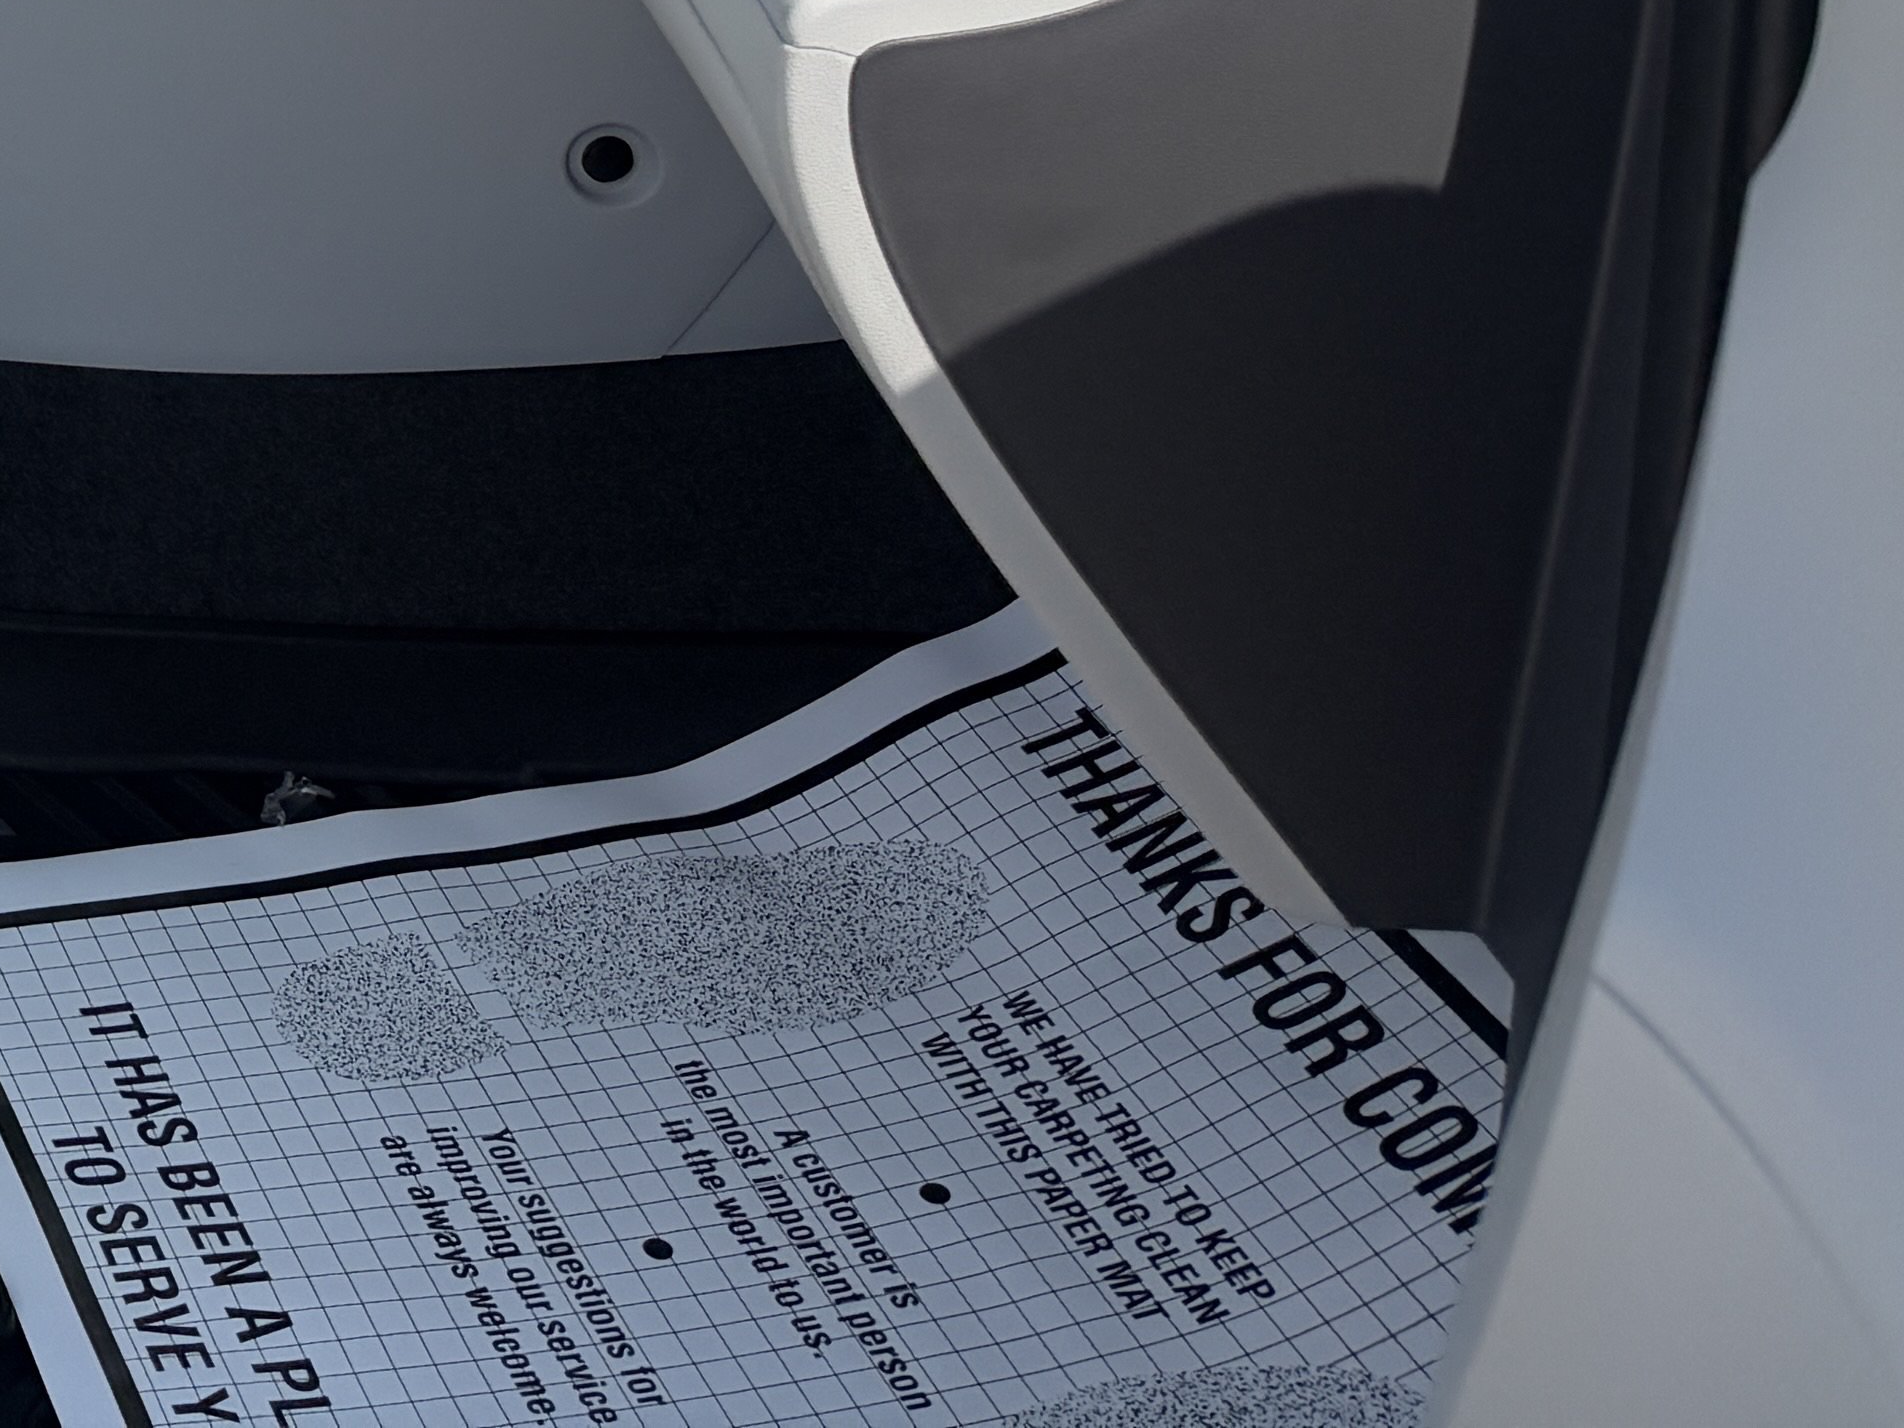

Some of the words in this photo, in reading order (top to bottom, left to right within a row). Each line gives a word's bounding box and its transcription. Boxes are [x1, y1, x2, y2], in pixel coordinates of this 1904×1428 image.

[79, 1002, 148, 1039] IT
[1020, 707, 1265, 944] THANKS
[1216, 932, 1386, 1078] FOR
[1343, 1067, 1498, 1245] COM
[52, 1125, 127, 1186] TO
[105, 1055, 198, 1147] HAS
[921, 1032, 992, 1100] WITH
[976, 1100, 1043, 1163] THIS
[1025, 1167, 1114, 1258] PAPER
[1097, 1259, 1170, 1320] MAT
[957, 1003, 1029, 1078] YOUR
[1013, 1080, 1150, 1228] CARPETING
[1135, 1230, 1230, 1325] CLEAN
[1002, 990, 1055, 1036] WE
[1038, 1035, 1111, 1105] HAVE
[1095, 1103, 1177, 1184] TRIED
[1163, 1184, 1211, 1226] TO
[1195, 1228, 1275, 1299] KEEP
[86, 1203, 215, 1372] SERVE
[157, 1161, 272, 1285] BEEN
[380, 1135, 421, 1176] are
[407, 1185, 479, 1279] always
[464, 1286, 556, 1426] welcome.
[426, 1126, 522, 1259] improving
[507, 1267, 554, 1312] our
[537, 1320, 619, 1425] service
[482, 1128, 534, 1187] Your
[518, 1194, 635, 1358] suggestions
[620, 1366, 667, 1406] for
[660, 1118, 695, 1143] in
[682, 1149, 726, 1190] the
[715, 1197, 789, 1273] world
[768, 1279, 804, 1308] to
[675, 1060, 717, 1100] the
[705, 1107, 771, 1169] most
[752, 1174, 866, 1305] important
[838, 1311, 933, 1411] person
[773, 1130, 811, 1149] A
[793, 1154, 899, 1275] customer
[884, 1281, 919, 1309] is
[172, 1387, 241, 1423] Y
[224, 1307, 293, 1343] A
